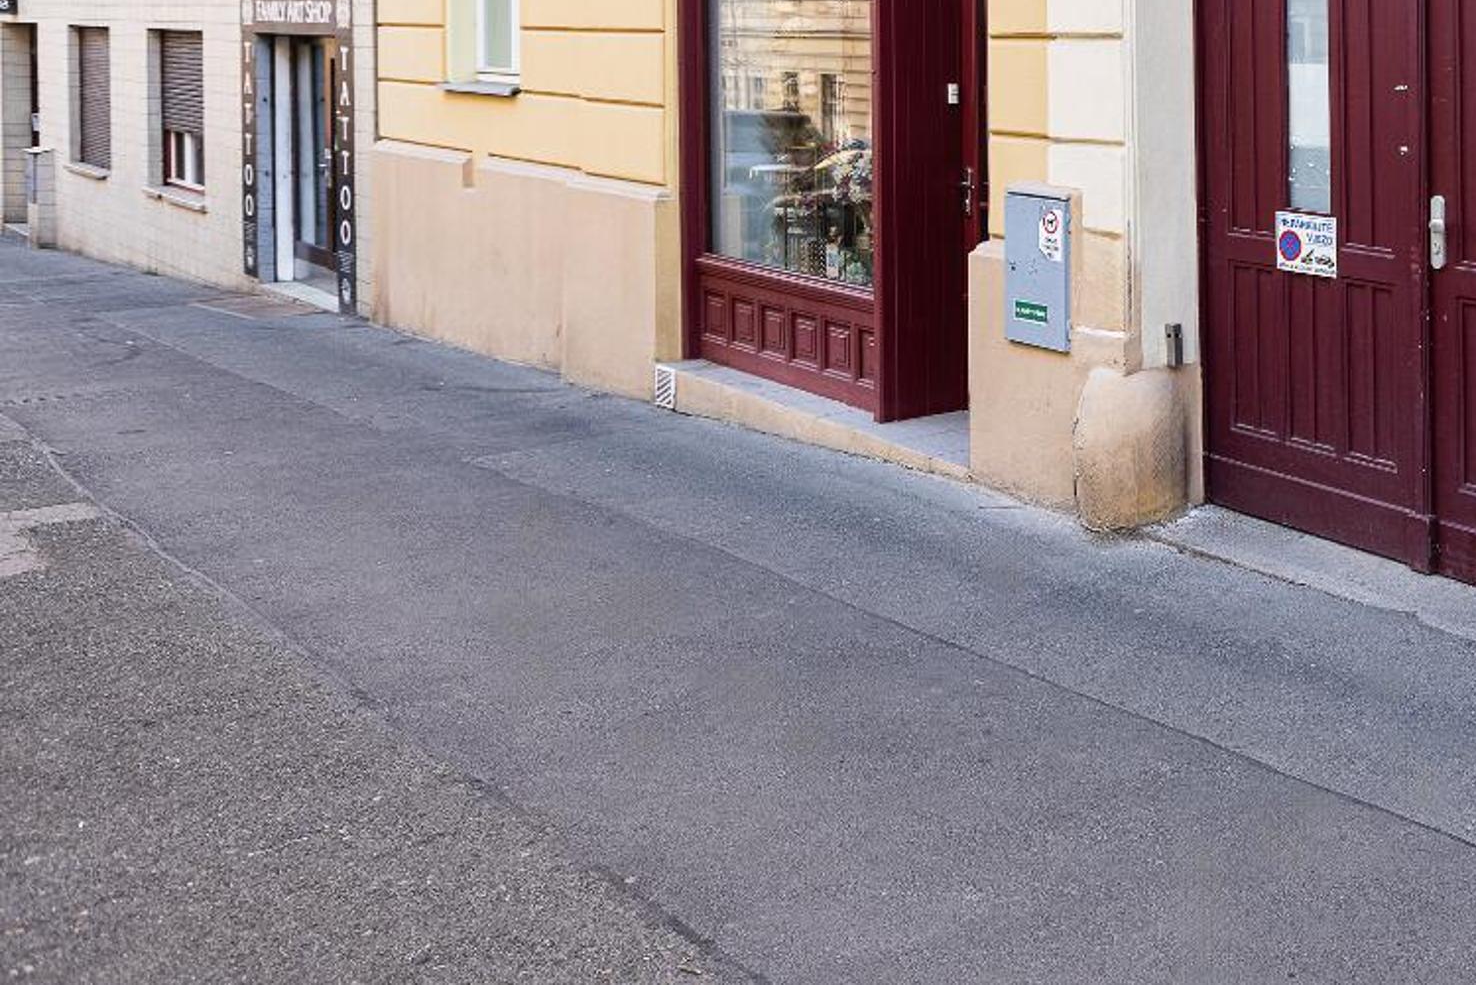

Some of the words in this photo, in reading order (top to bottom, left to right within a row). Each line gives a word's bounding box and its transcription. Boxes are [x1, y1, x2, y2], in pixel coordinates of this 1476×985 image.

[255, 0, 287, 22] FAMILY
[286, 0, 304, 23] ART
[304, 0, 333, 24] SHOP
[243, 41, 255, 216] TATTOO
[339, 46, 351, 245] TATTOO
